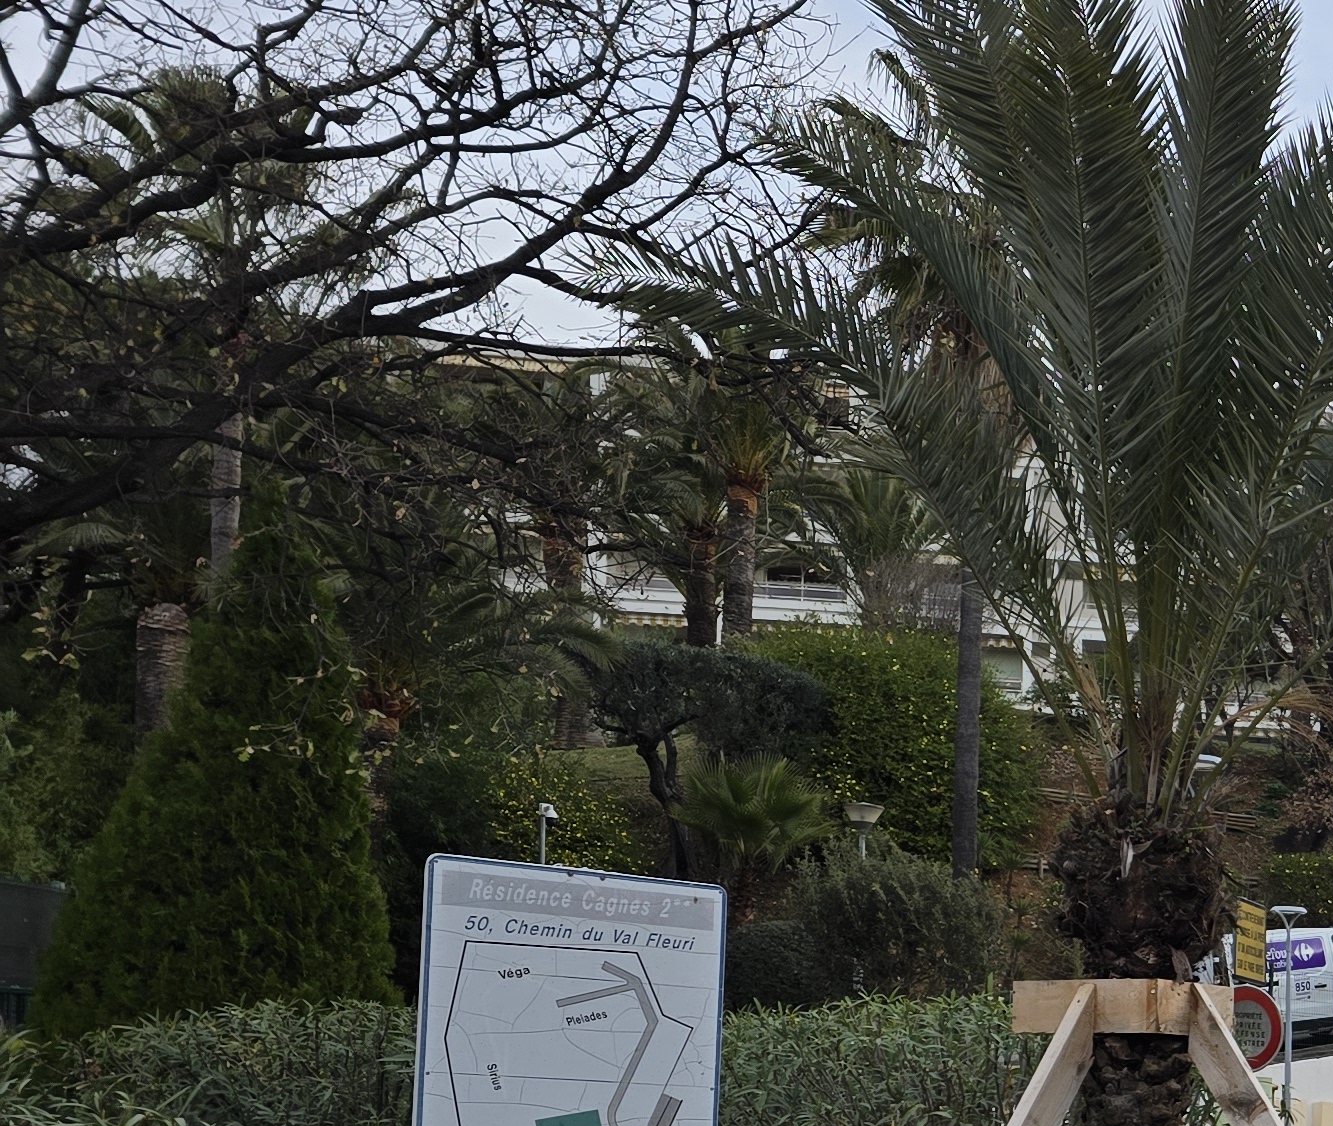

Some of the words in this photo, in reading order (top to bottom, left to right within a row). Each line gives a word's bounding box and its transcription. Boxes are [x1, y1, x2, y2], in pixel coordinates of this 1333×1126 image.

[468, 878, 572, 908] Résidence
[581, 890, 651, 918] Cagnes
[464, 915, 493, 934] 50,
[505, 918, 573, 939] Chemin
[582, 926, 604, 942] du
[613, 929, 639, 946] Val
[645, 932, 696, 951] Fleuri
[497, 966, 531, 980] Véga
[1295, 981, 1311, 992] 850
[565, 1011, 608, 1026] Pleiades
[486, 1063, 502, 1091] Sirius
